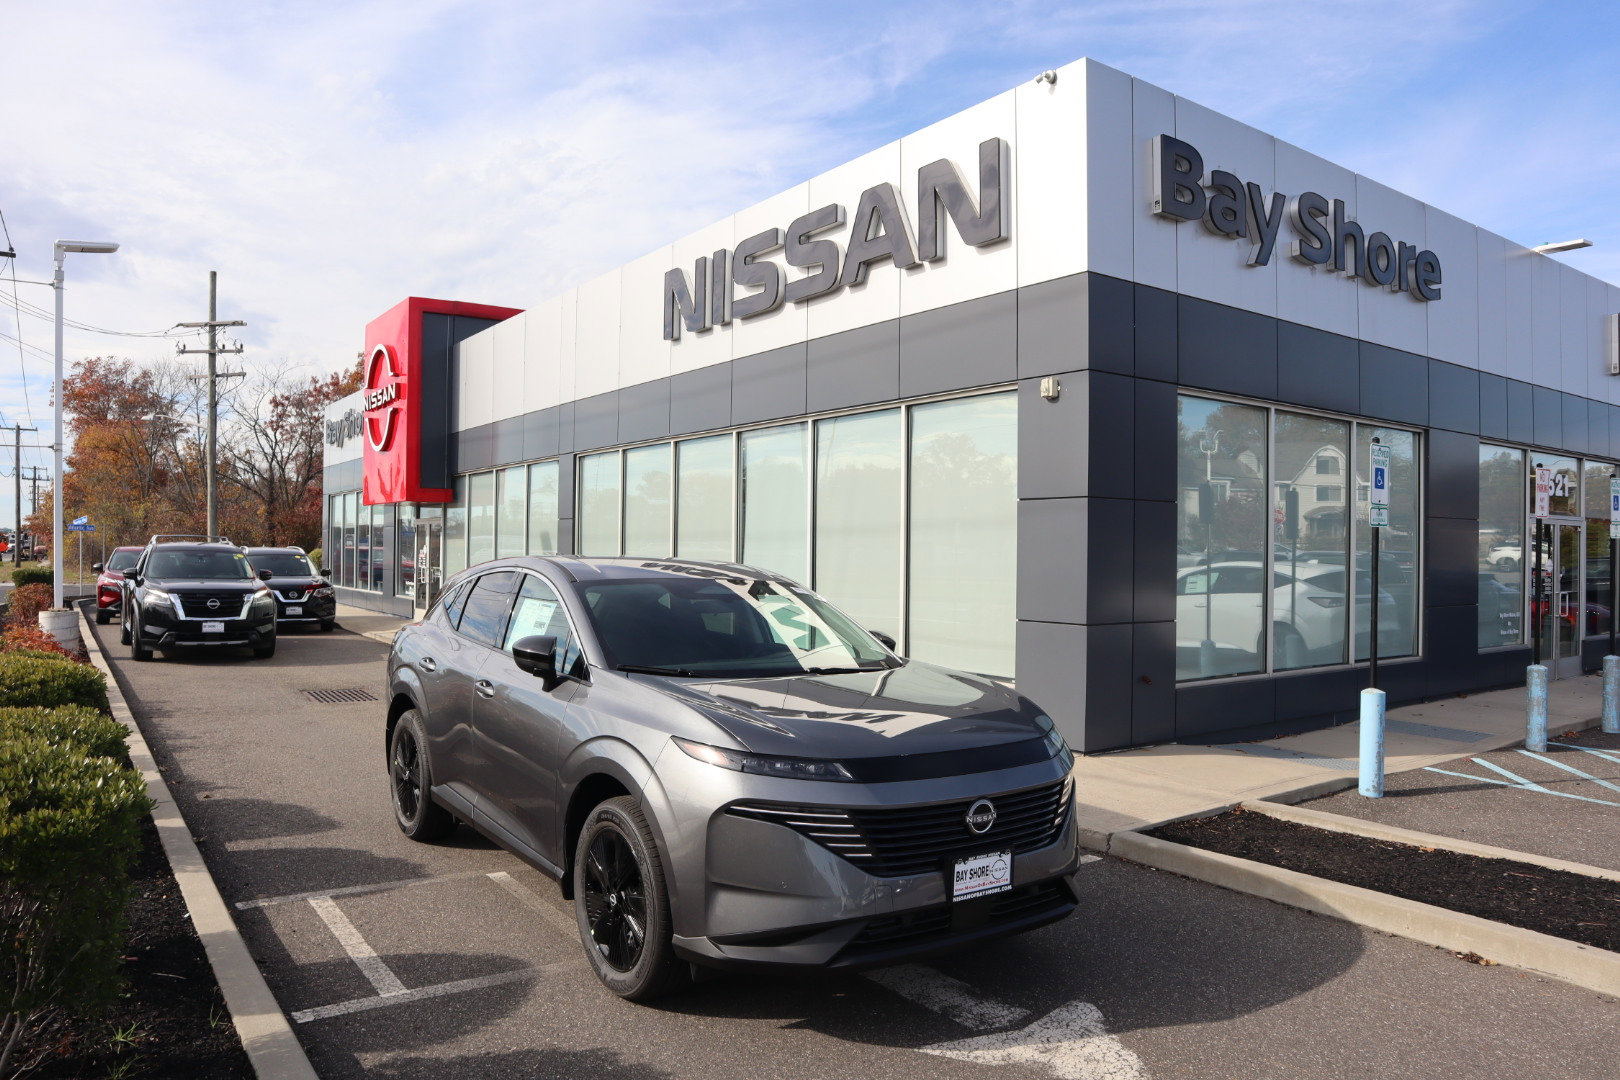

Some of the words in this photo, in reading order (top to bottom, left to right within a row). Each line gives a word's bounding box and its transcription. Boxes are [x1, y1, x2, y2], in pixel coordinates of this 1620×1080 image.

[1152, 134, 1286, 266] Bay
[1290, 191, 1442, 301] Shore
[664, 137, 1007, 341] NISSAN
[364, 383, 396, 411] NISSAN
[966, 813, 997, 823] NISSAN
[955, 869, 969, 882] BAY
[969, 865, 990, 880] SHORE
